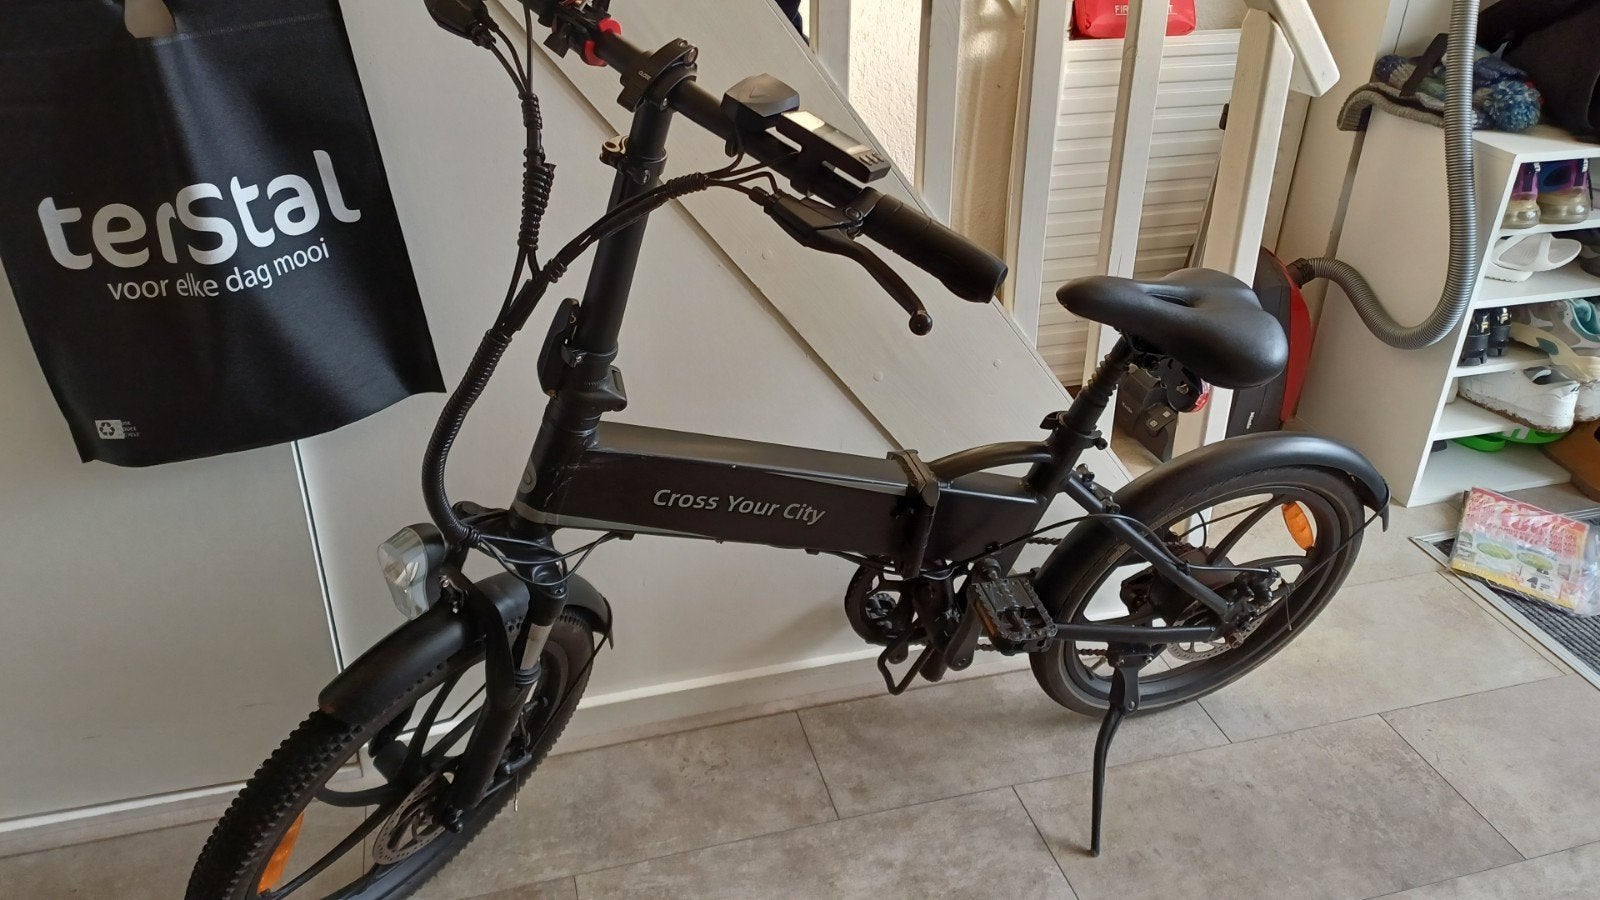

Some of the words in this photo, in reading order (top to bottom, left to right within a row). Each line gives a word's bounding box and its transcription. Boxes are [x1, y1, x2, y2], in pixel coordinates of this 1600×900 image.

[37, 150, 362, 270] terStal
[107, 279, 169, 300] voor
[176, 272, 220, 297] elke
[226, 264, 273, 293] dag
[273, 237, 330, 276] mooi
[653, 489, 720, 510] Cross
[727, 495, 781, 516] Your
[783, 503, 826, 526] City
